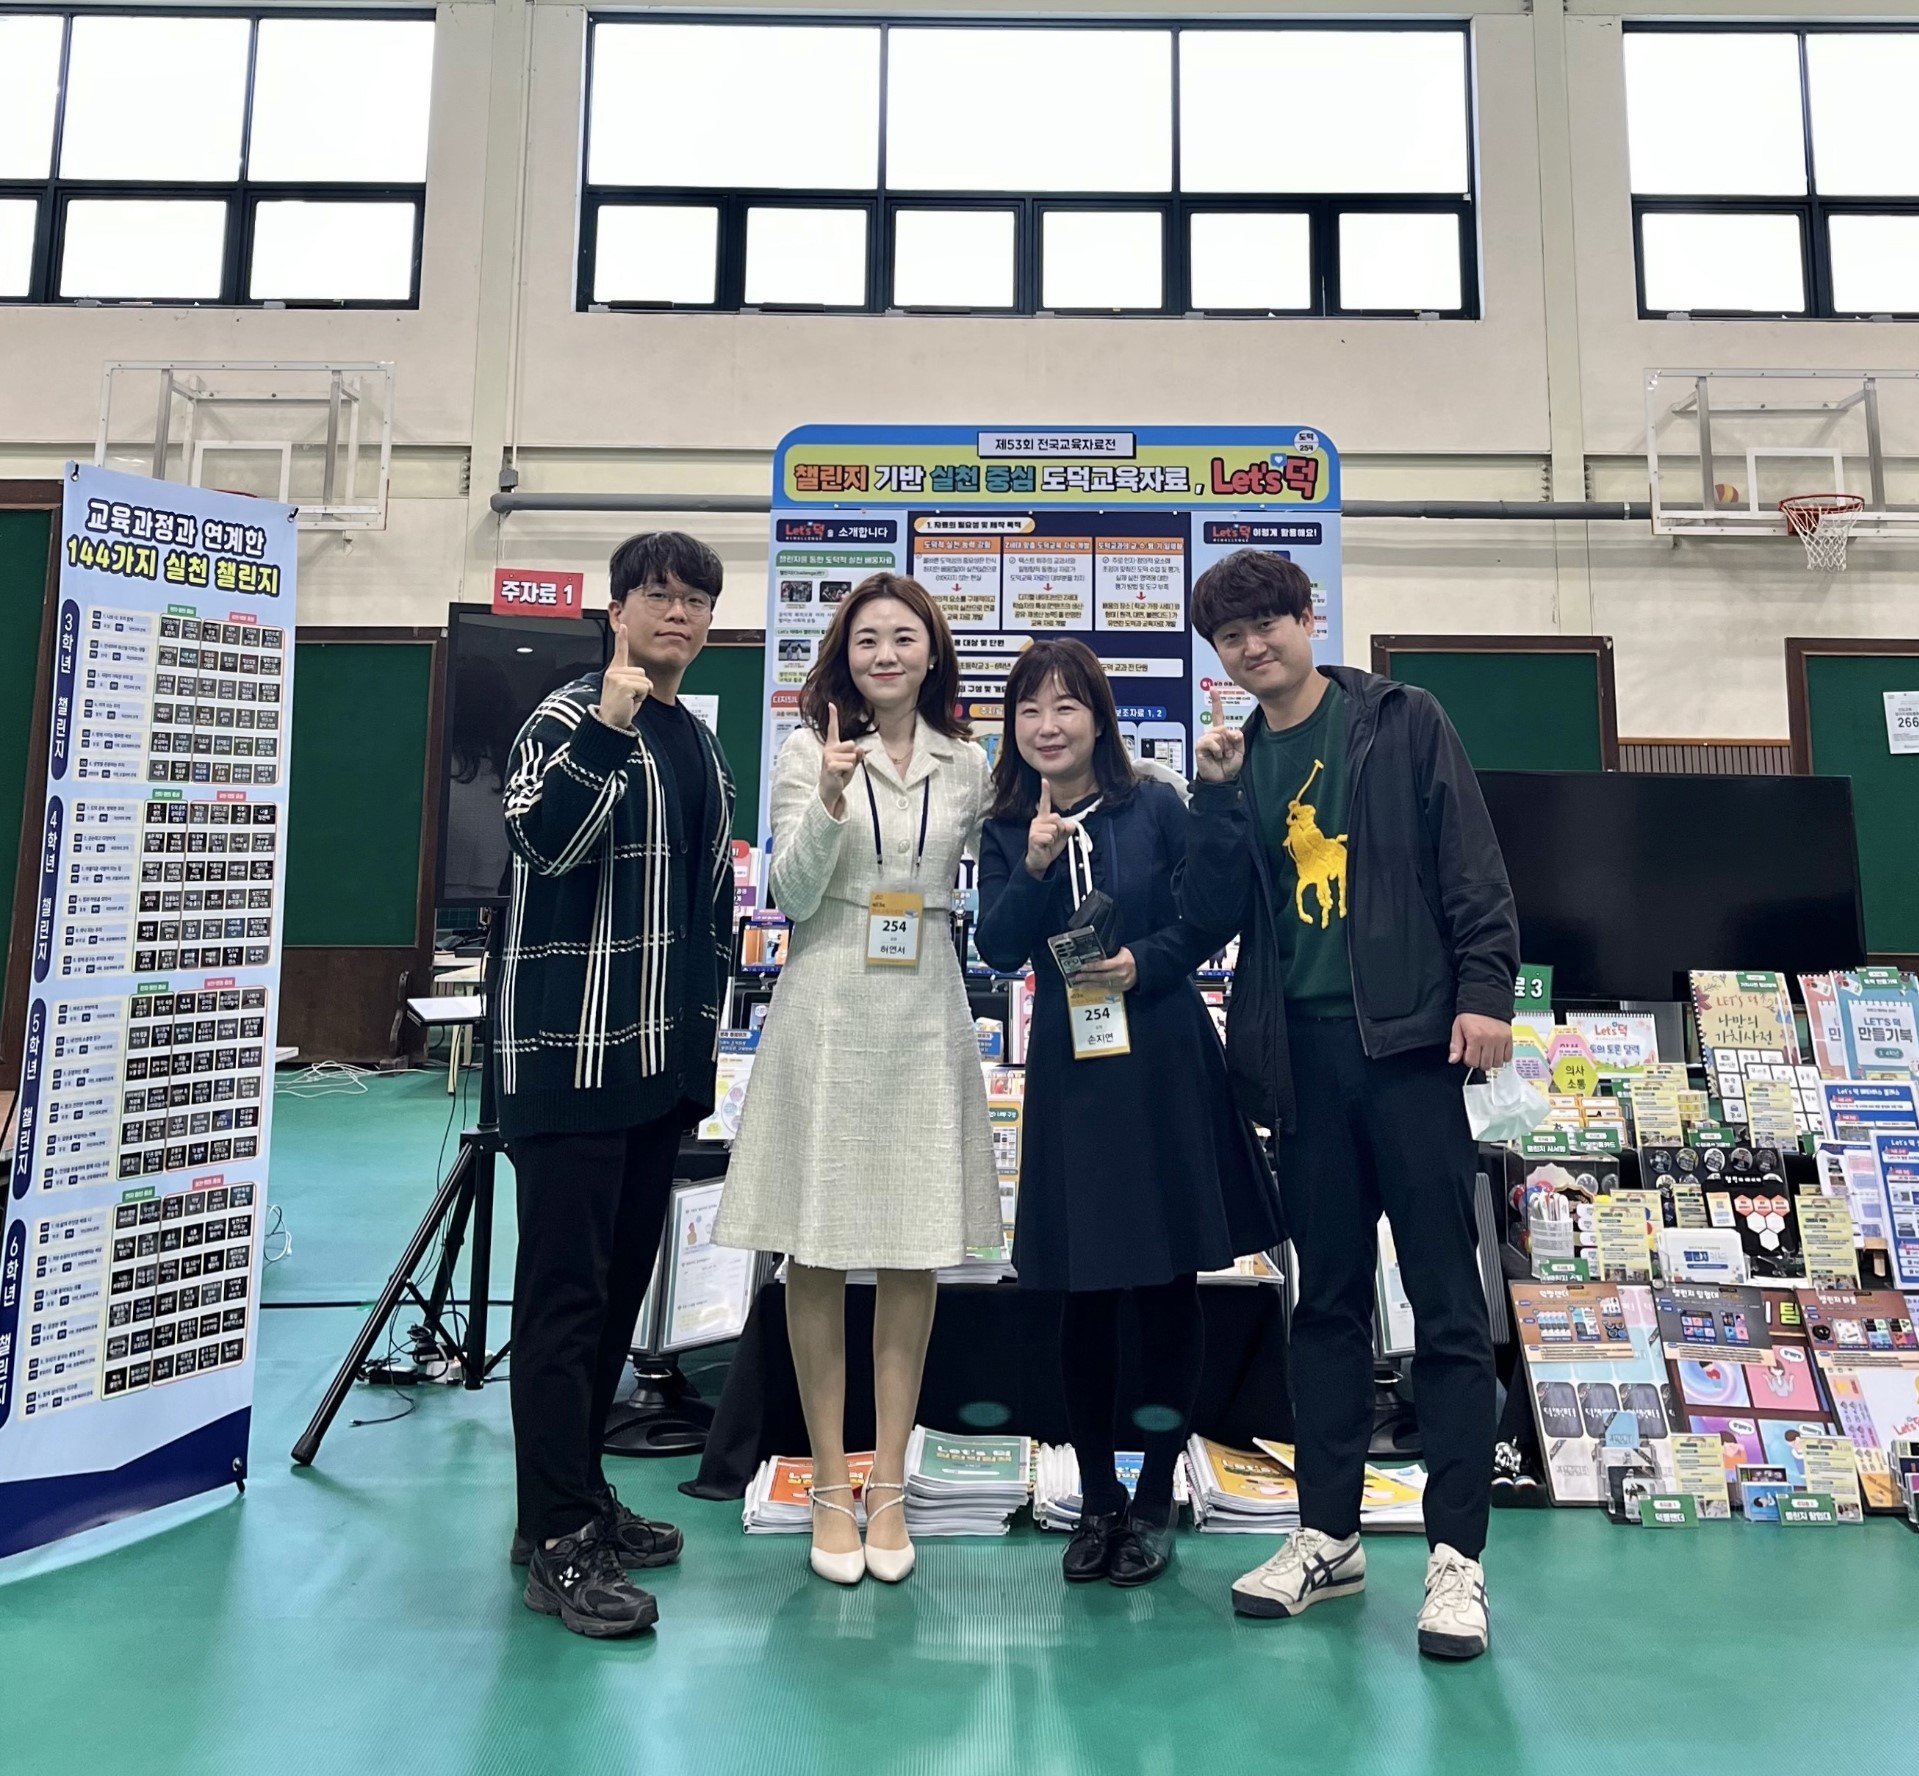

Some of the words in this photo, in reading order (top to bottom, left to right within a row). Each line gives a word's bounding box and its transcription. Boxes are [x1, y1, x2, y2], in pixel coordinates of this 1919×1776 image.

[995, 438, 1034, 451] 제53회
[1037, 438, 1116, 451] 전국교육자료전
[794, 463, 869, 492] 챌린지
[874, 465, 926, 492] 기반
[930, 464, 980, 492] 실천
[985, 464, 1036, 492] 중심
[85, 498, 198, 545] 교육과정과
[202, 520, 266, 557] 연계한
[838, 527, 888, 539] 소개합니다
[1253, 528, 1278, 537] 이렇게
[67, 535, 159, 577] 144가지
[164, 552, 210, 586] 실천
[214, 557, 281, 598] 챌린지
[501, 580, 557, 605] 주자료
[563, 584, 574, 604] 1
[60, 612, 74, 676] 3학년
[54, 696, 68, 760] 챌린지
[1898, 716, 1919, 728] 266
[44, 809, 58, 874] 4학년
[36, 897, 52, 961] 챌린지
[882, 920, 906, 933] 254
[880, 946, 906, 955] 허연서
[1530, 977, 1543, 998] 3
[1084, 1007, 1110, 1022] 254
[1718, 1014, 1759, 1029] 나만의
[1864, 1017, 1892, 1027] LET'S
[1088, 1033, 1114, 1046] 손지연
[1716, 1029, 1773, 1046] 가치사전
[1858, 1026, 1914, 1044] 만들기북
[26, 1012, 40, 1080] 5학년
[1565, 1065, 1584, 1076] 의사
[1568, 1079, 1586, 1090] 소통
[16, 1108, 33, 1176] 챌린지
